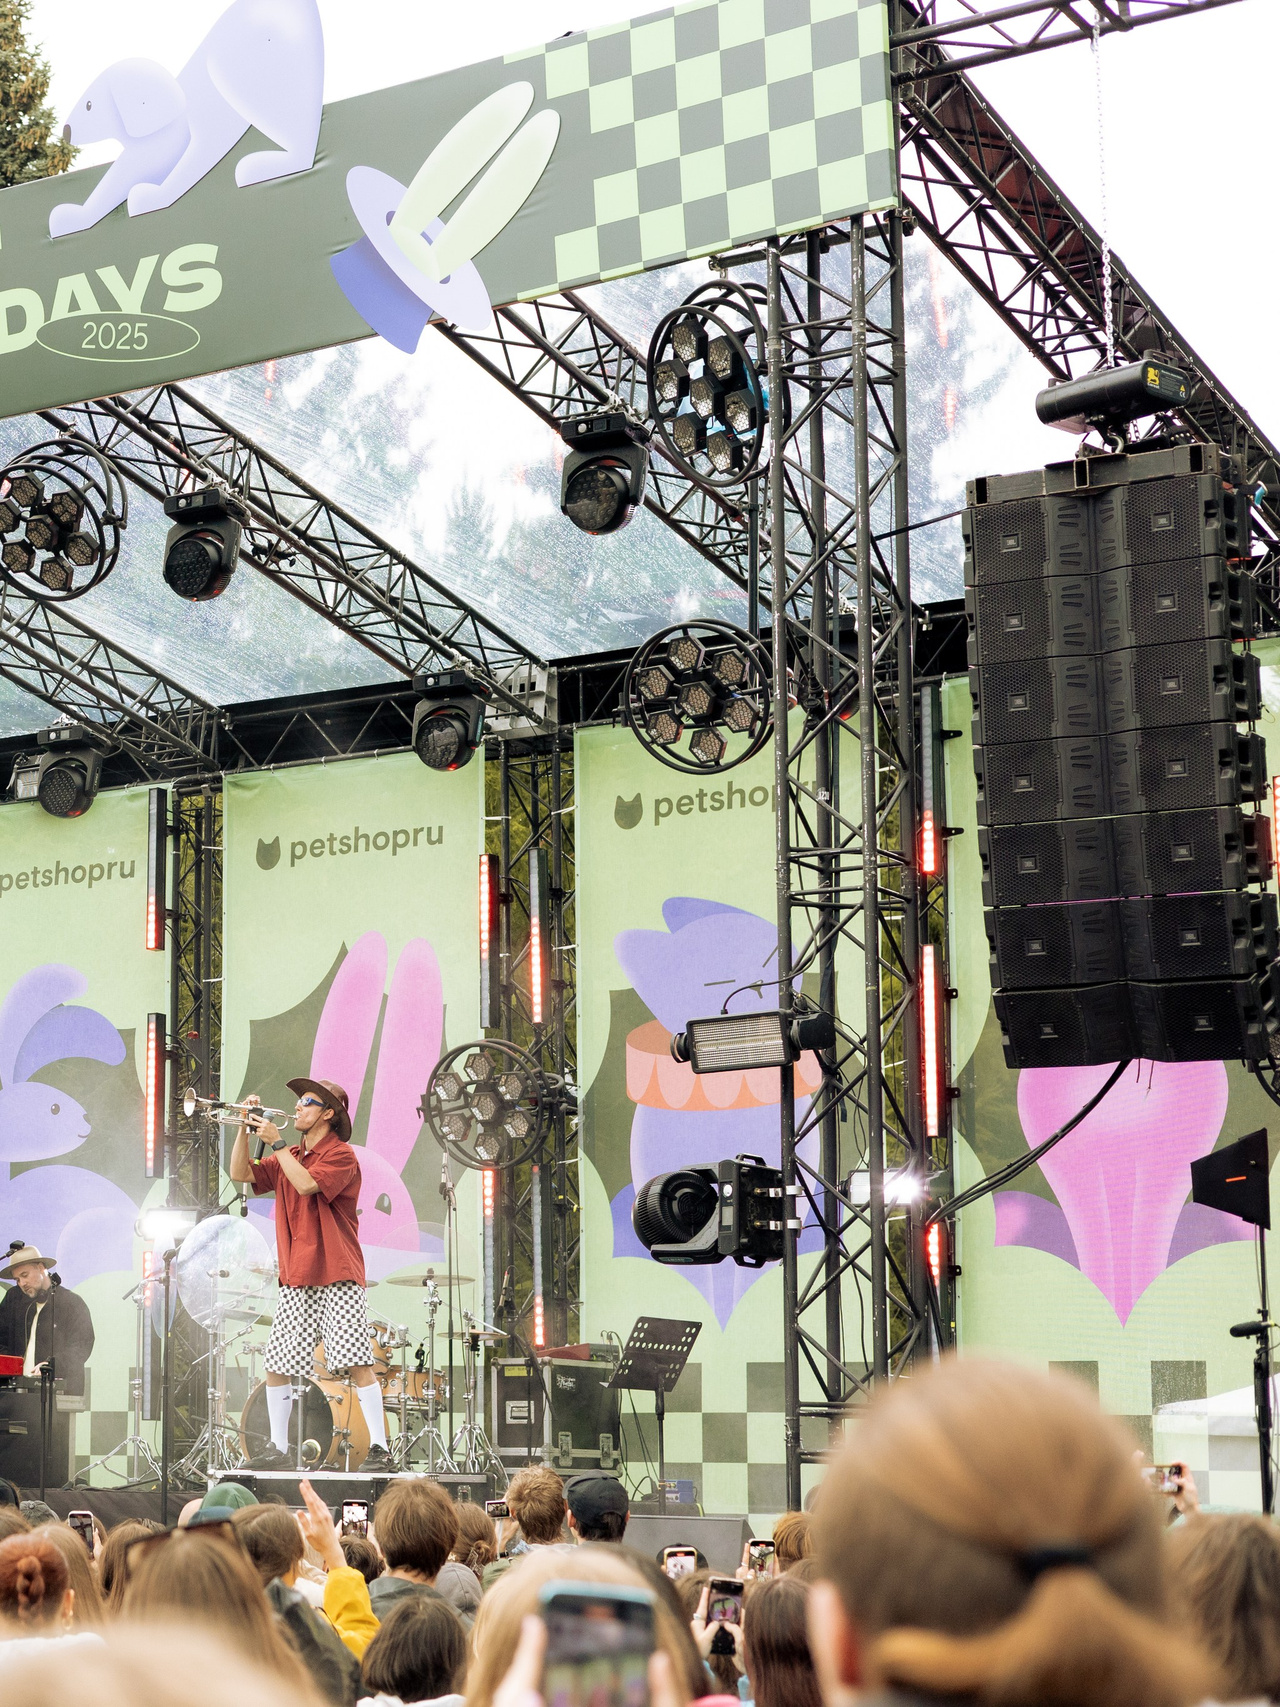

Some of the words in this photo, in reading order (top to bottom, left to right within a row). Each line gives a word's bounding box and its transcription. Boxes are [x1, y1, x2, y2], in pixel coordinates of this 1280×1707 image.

[81, 321, 148, 351] 2025
[654, 780, 817, 826] petsho
[290, 825, 444, 868] petshopru
